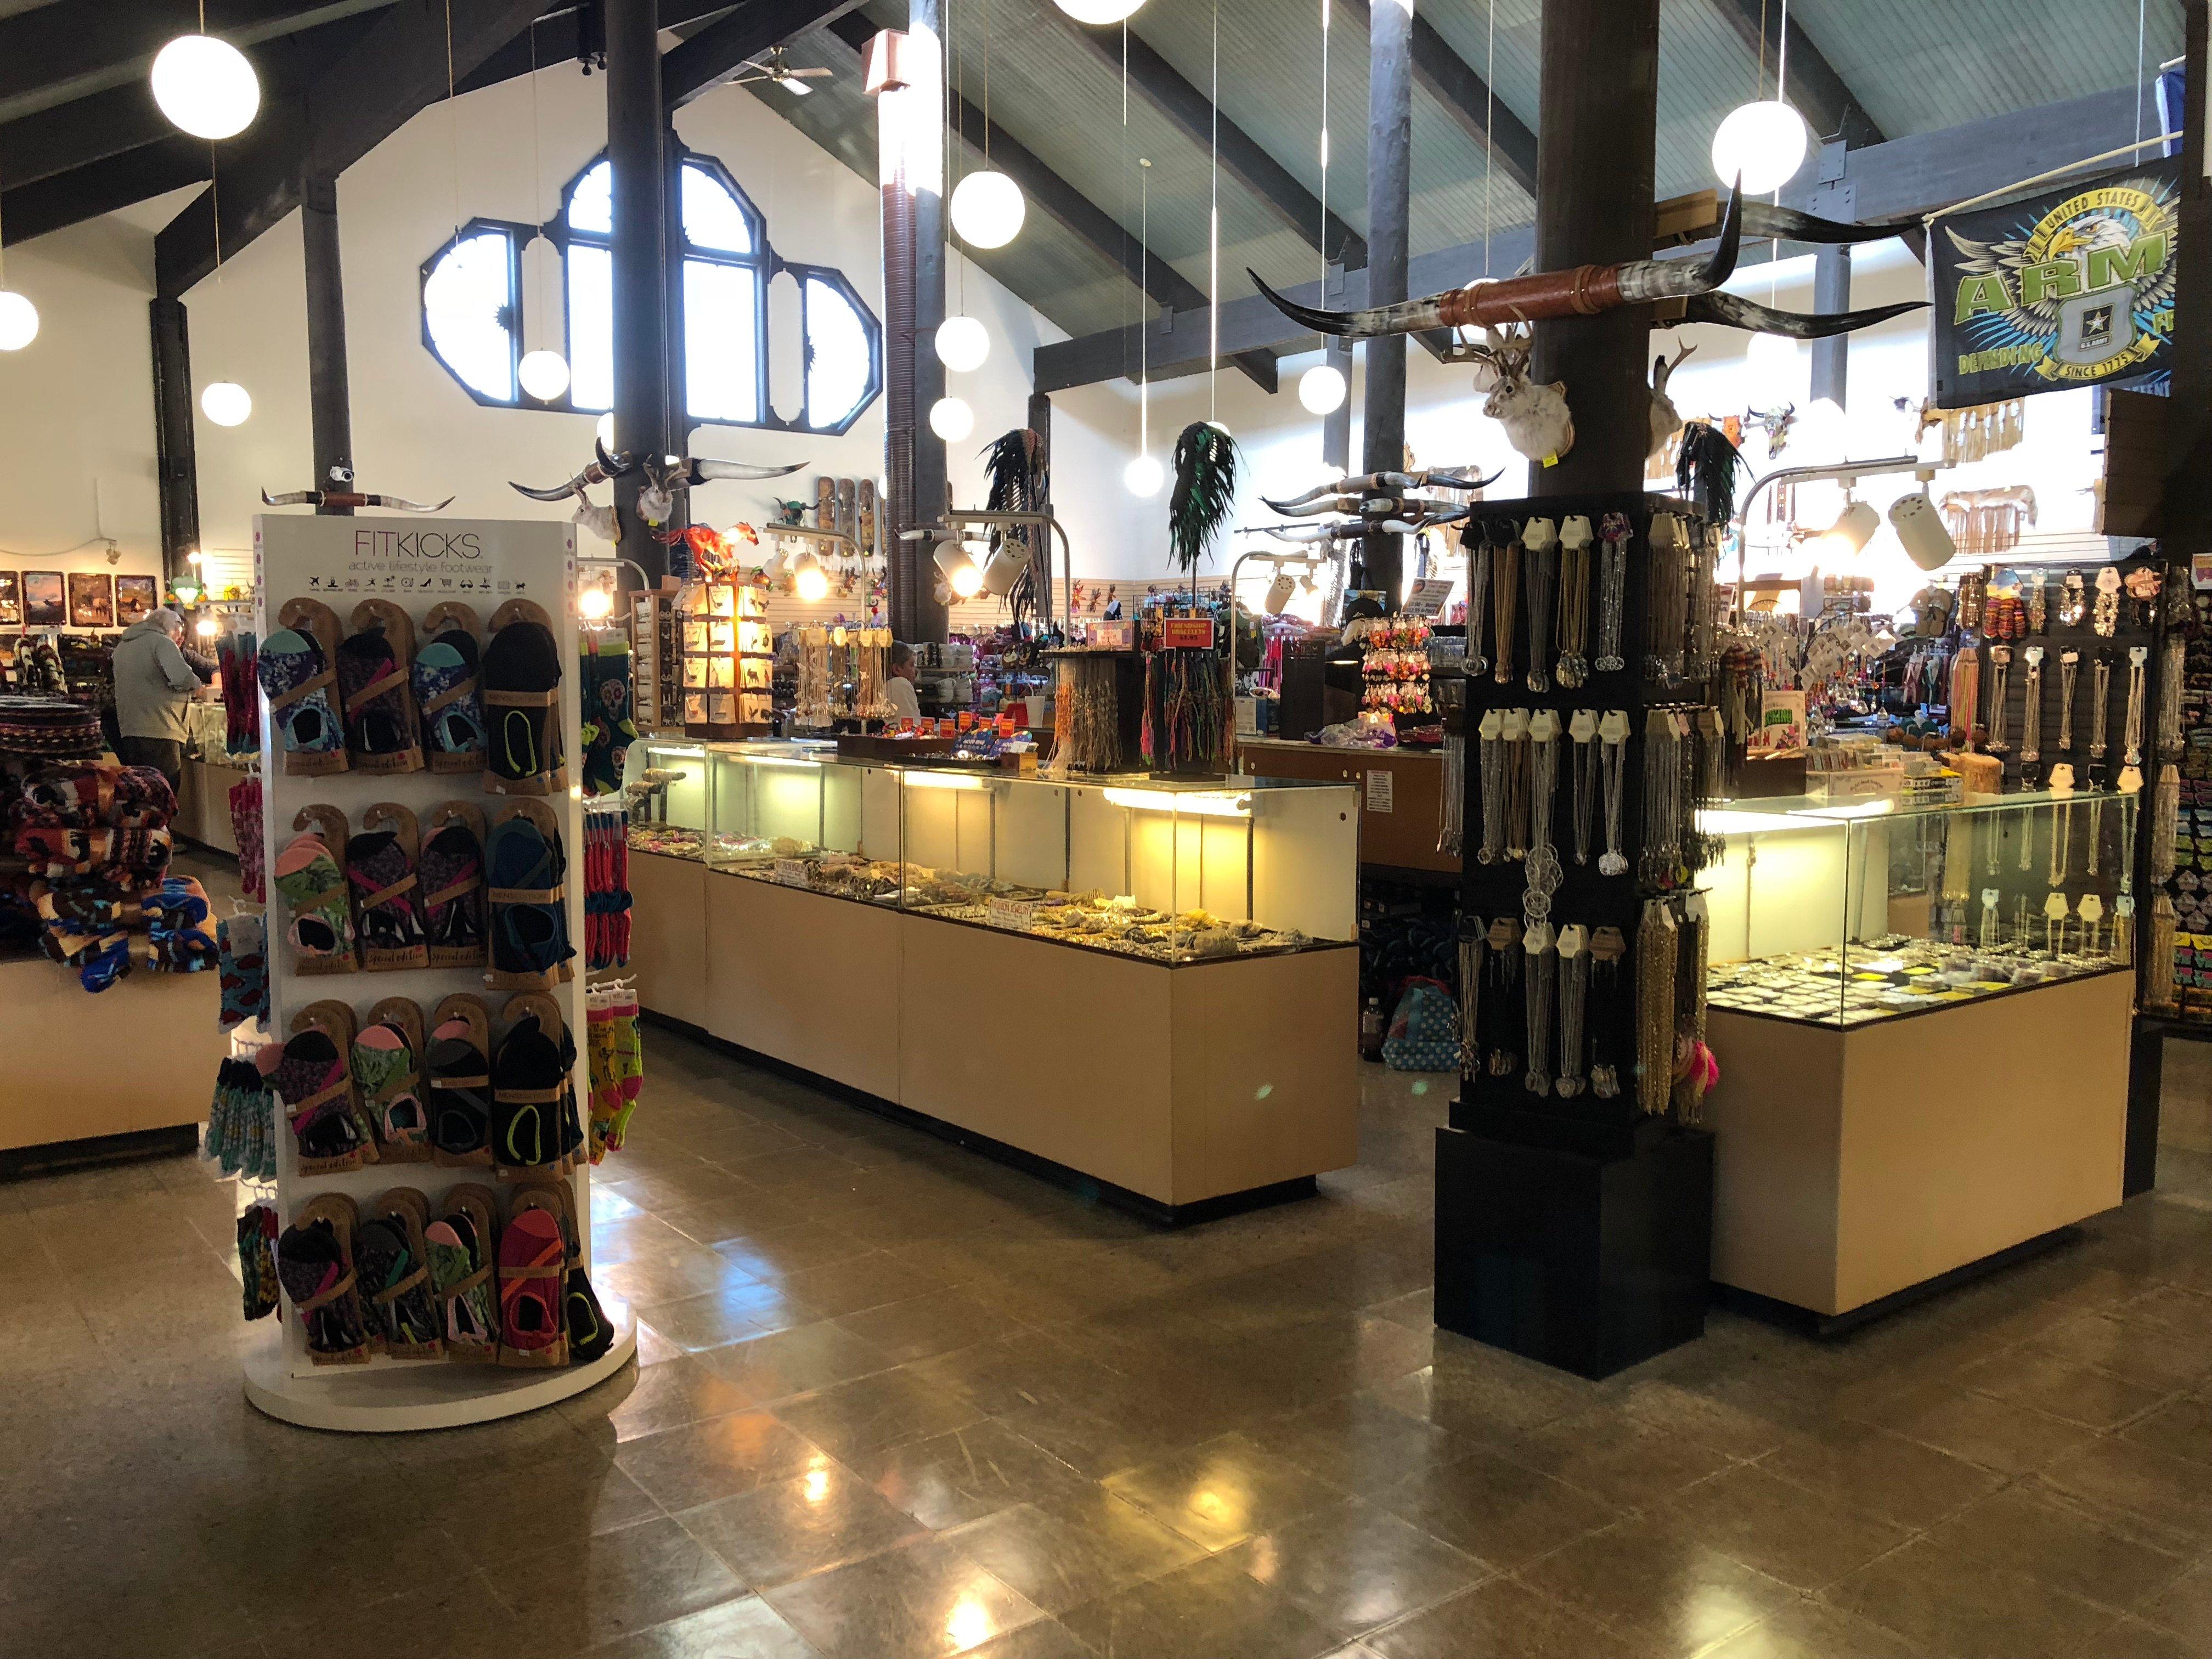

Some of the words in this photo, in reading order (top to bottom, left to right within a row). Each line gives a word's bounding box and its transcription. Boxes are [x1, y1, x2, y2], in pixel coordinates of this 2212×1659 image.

[2045, 197, 2089, 228] UNITED
[2097, 192, 2140, 207] STATES
[1954, 229, 2168, 325] ARM
[2065, 365, 2096, 377] SINCE
[2102, 354, 2129, 373] 1775
[355, 530, 481, 559] FITKICKS
[348, 560, 385, 571] active
[389, 560, 437, 574] lifestyle
[441, 561, 493, 574] footwear
[368, 950, 394, 966] special
[432, 950, 458, 963] special
